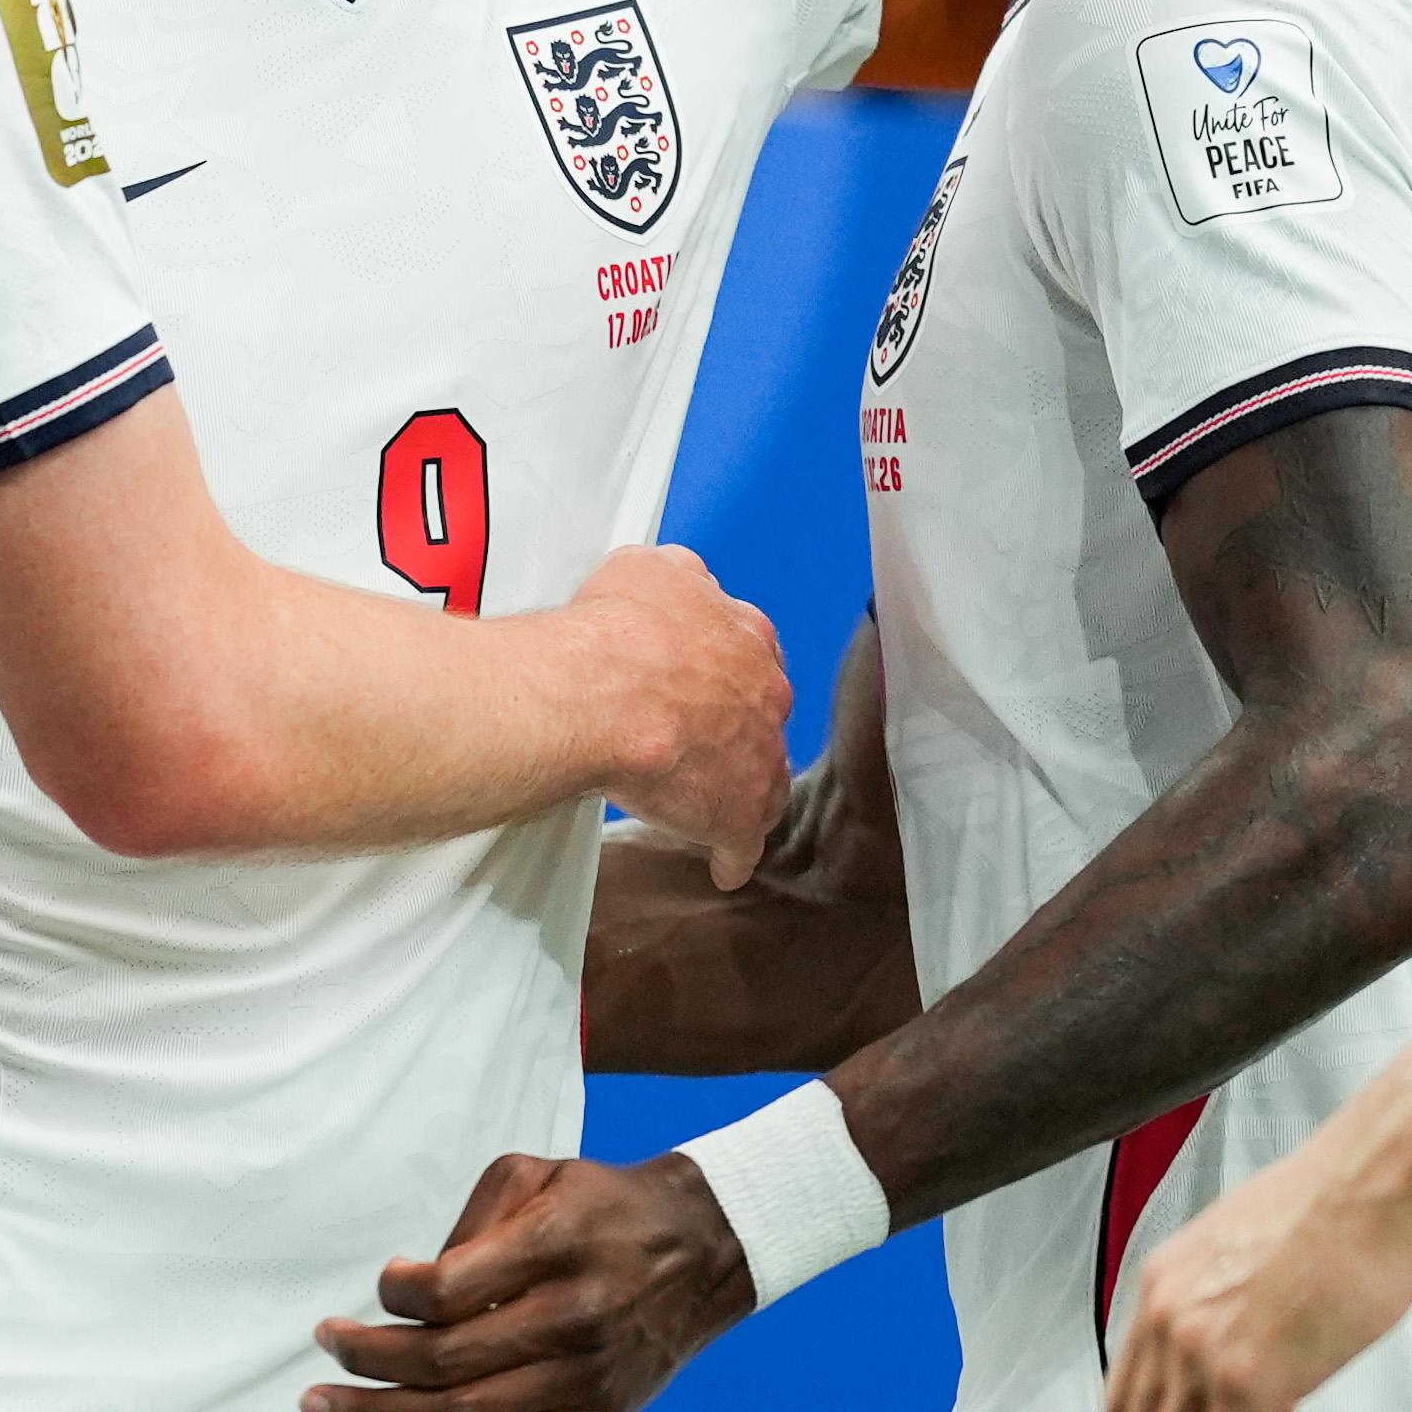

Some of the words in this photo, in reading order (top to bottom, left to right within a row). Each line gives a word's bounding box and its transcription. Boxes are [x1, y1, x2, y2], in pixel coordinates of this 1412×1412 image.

[60, 123, 91, 143] WORL
[1193, 102, 1253, 142] Unite
[1253, 96, 1289, 131] For
[63, 138, 104, 168] 202
[1205, 136, 1295, 178] PEACE
[1232, 178, 1280, 199] FIFA
[597, 253, 674, 301] CROATI
[377, 408, 490, 619] 9
